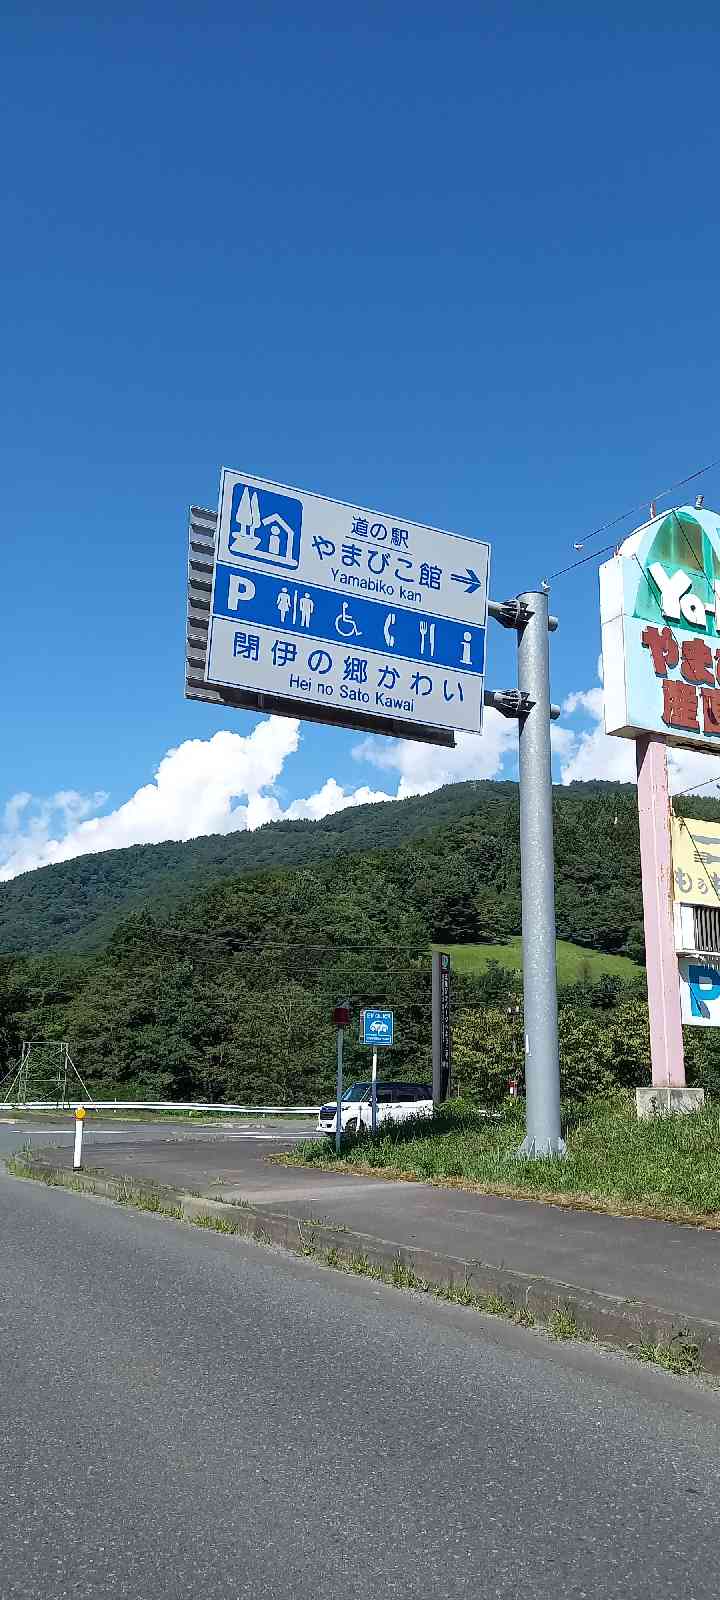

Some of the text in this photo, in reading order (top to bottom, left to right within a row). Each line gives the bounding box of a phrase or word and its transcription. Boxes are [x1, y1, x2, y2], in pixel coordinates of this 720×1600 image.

[351, 515, 410, 549] 道の駅
[312, 535, 443, 591] やまびこ館
[227, 574, 256, 611] P
[330, 568, 423, 603] Yamabiko kan
[232, 631, 465, 702] 閉伊の郷かわい
[289, 674, 415, 713] Hei no Sato Kawai
